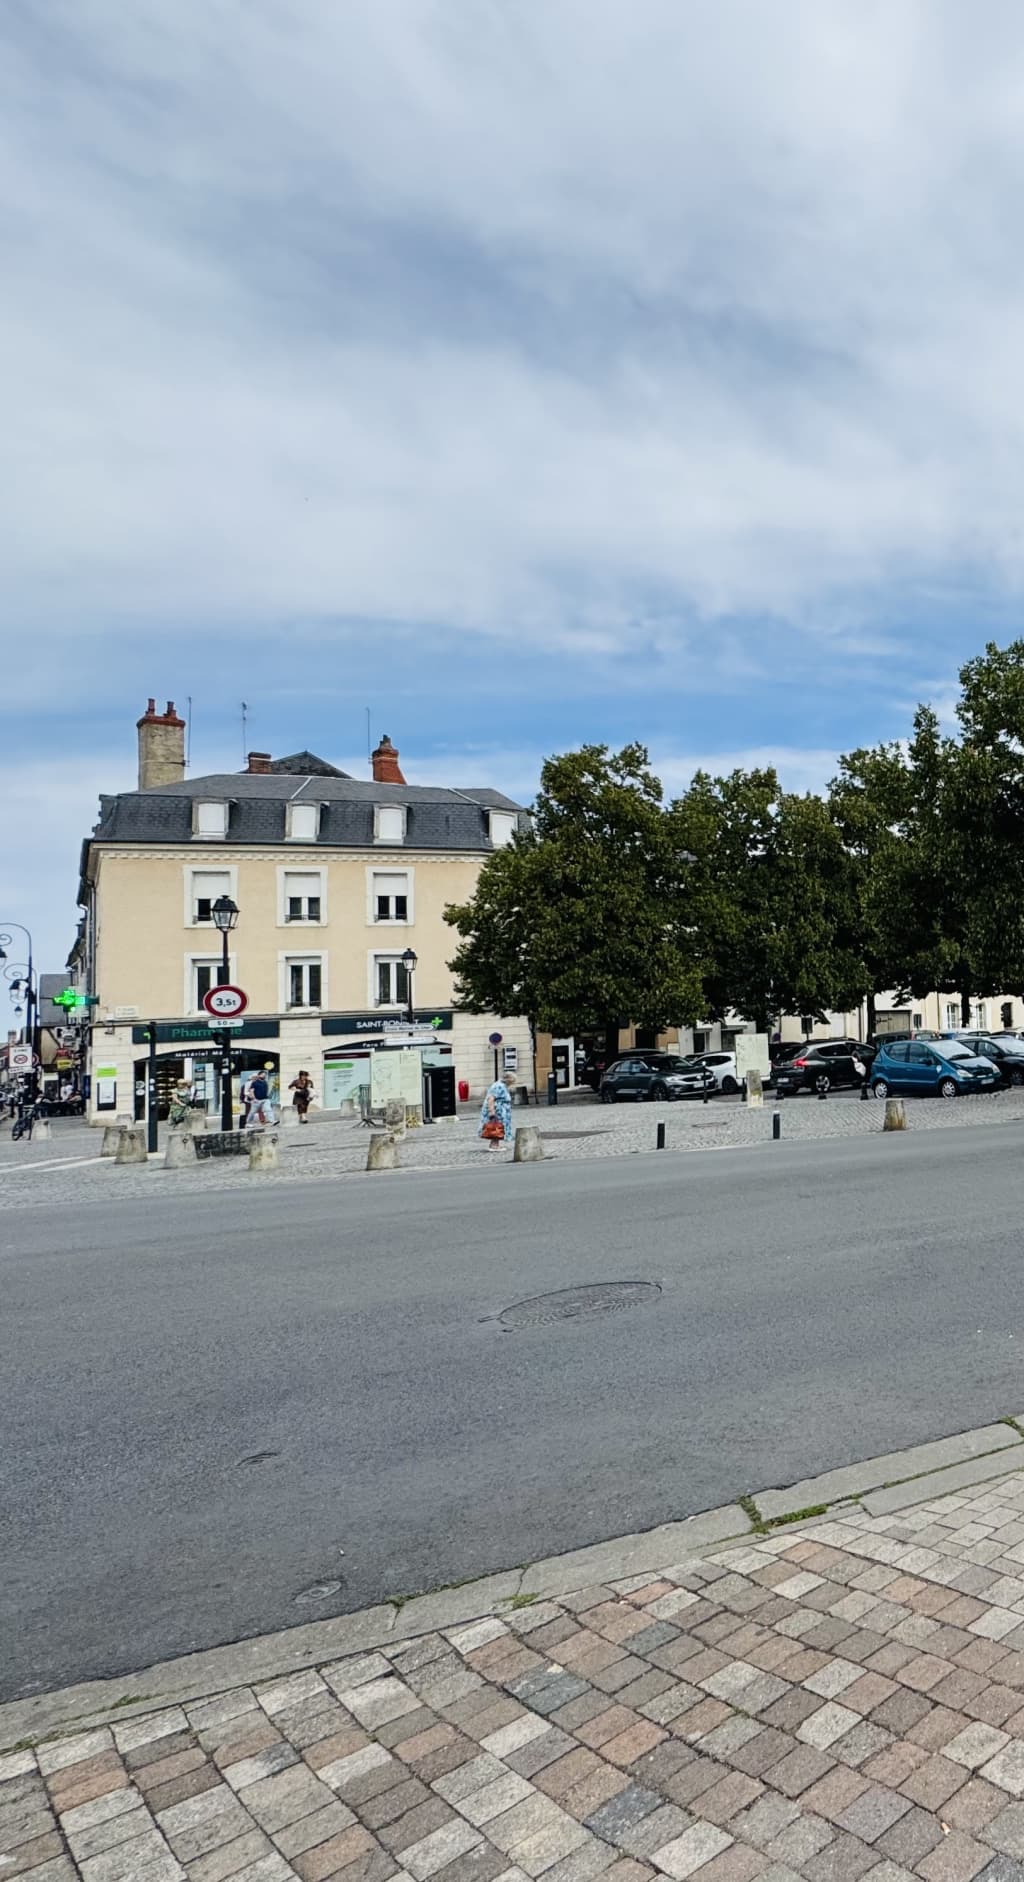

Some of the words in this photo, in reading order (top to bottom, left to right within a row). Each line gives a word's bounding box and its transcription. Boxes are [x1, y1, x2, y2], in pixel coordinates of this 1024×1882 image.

[216, 997, 236, 1008] 3,5t
[356, 1019, 419, 1029] SAINT-BONT
[172, 1026, 242, 1038] Pharmaie
